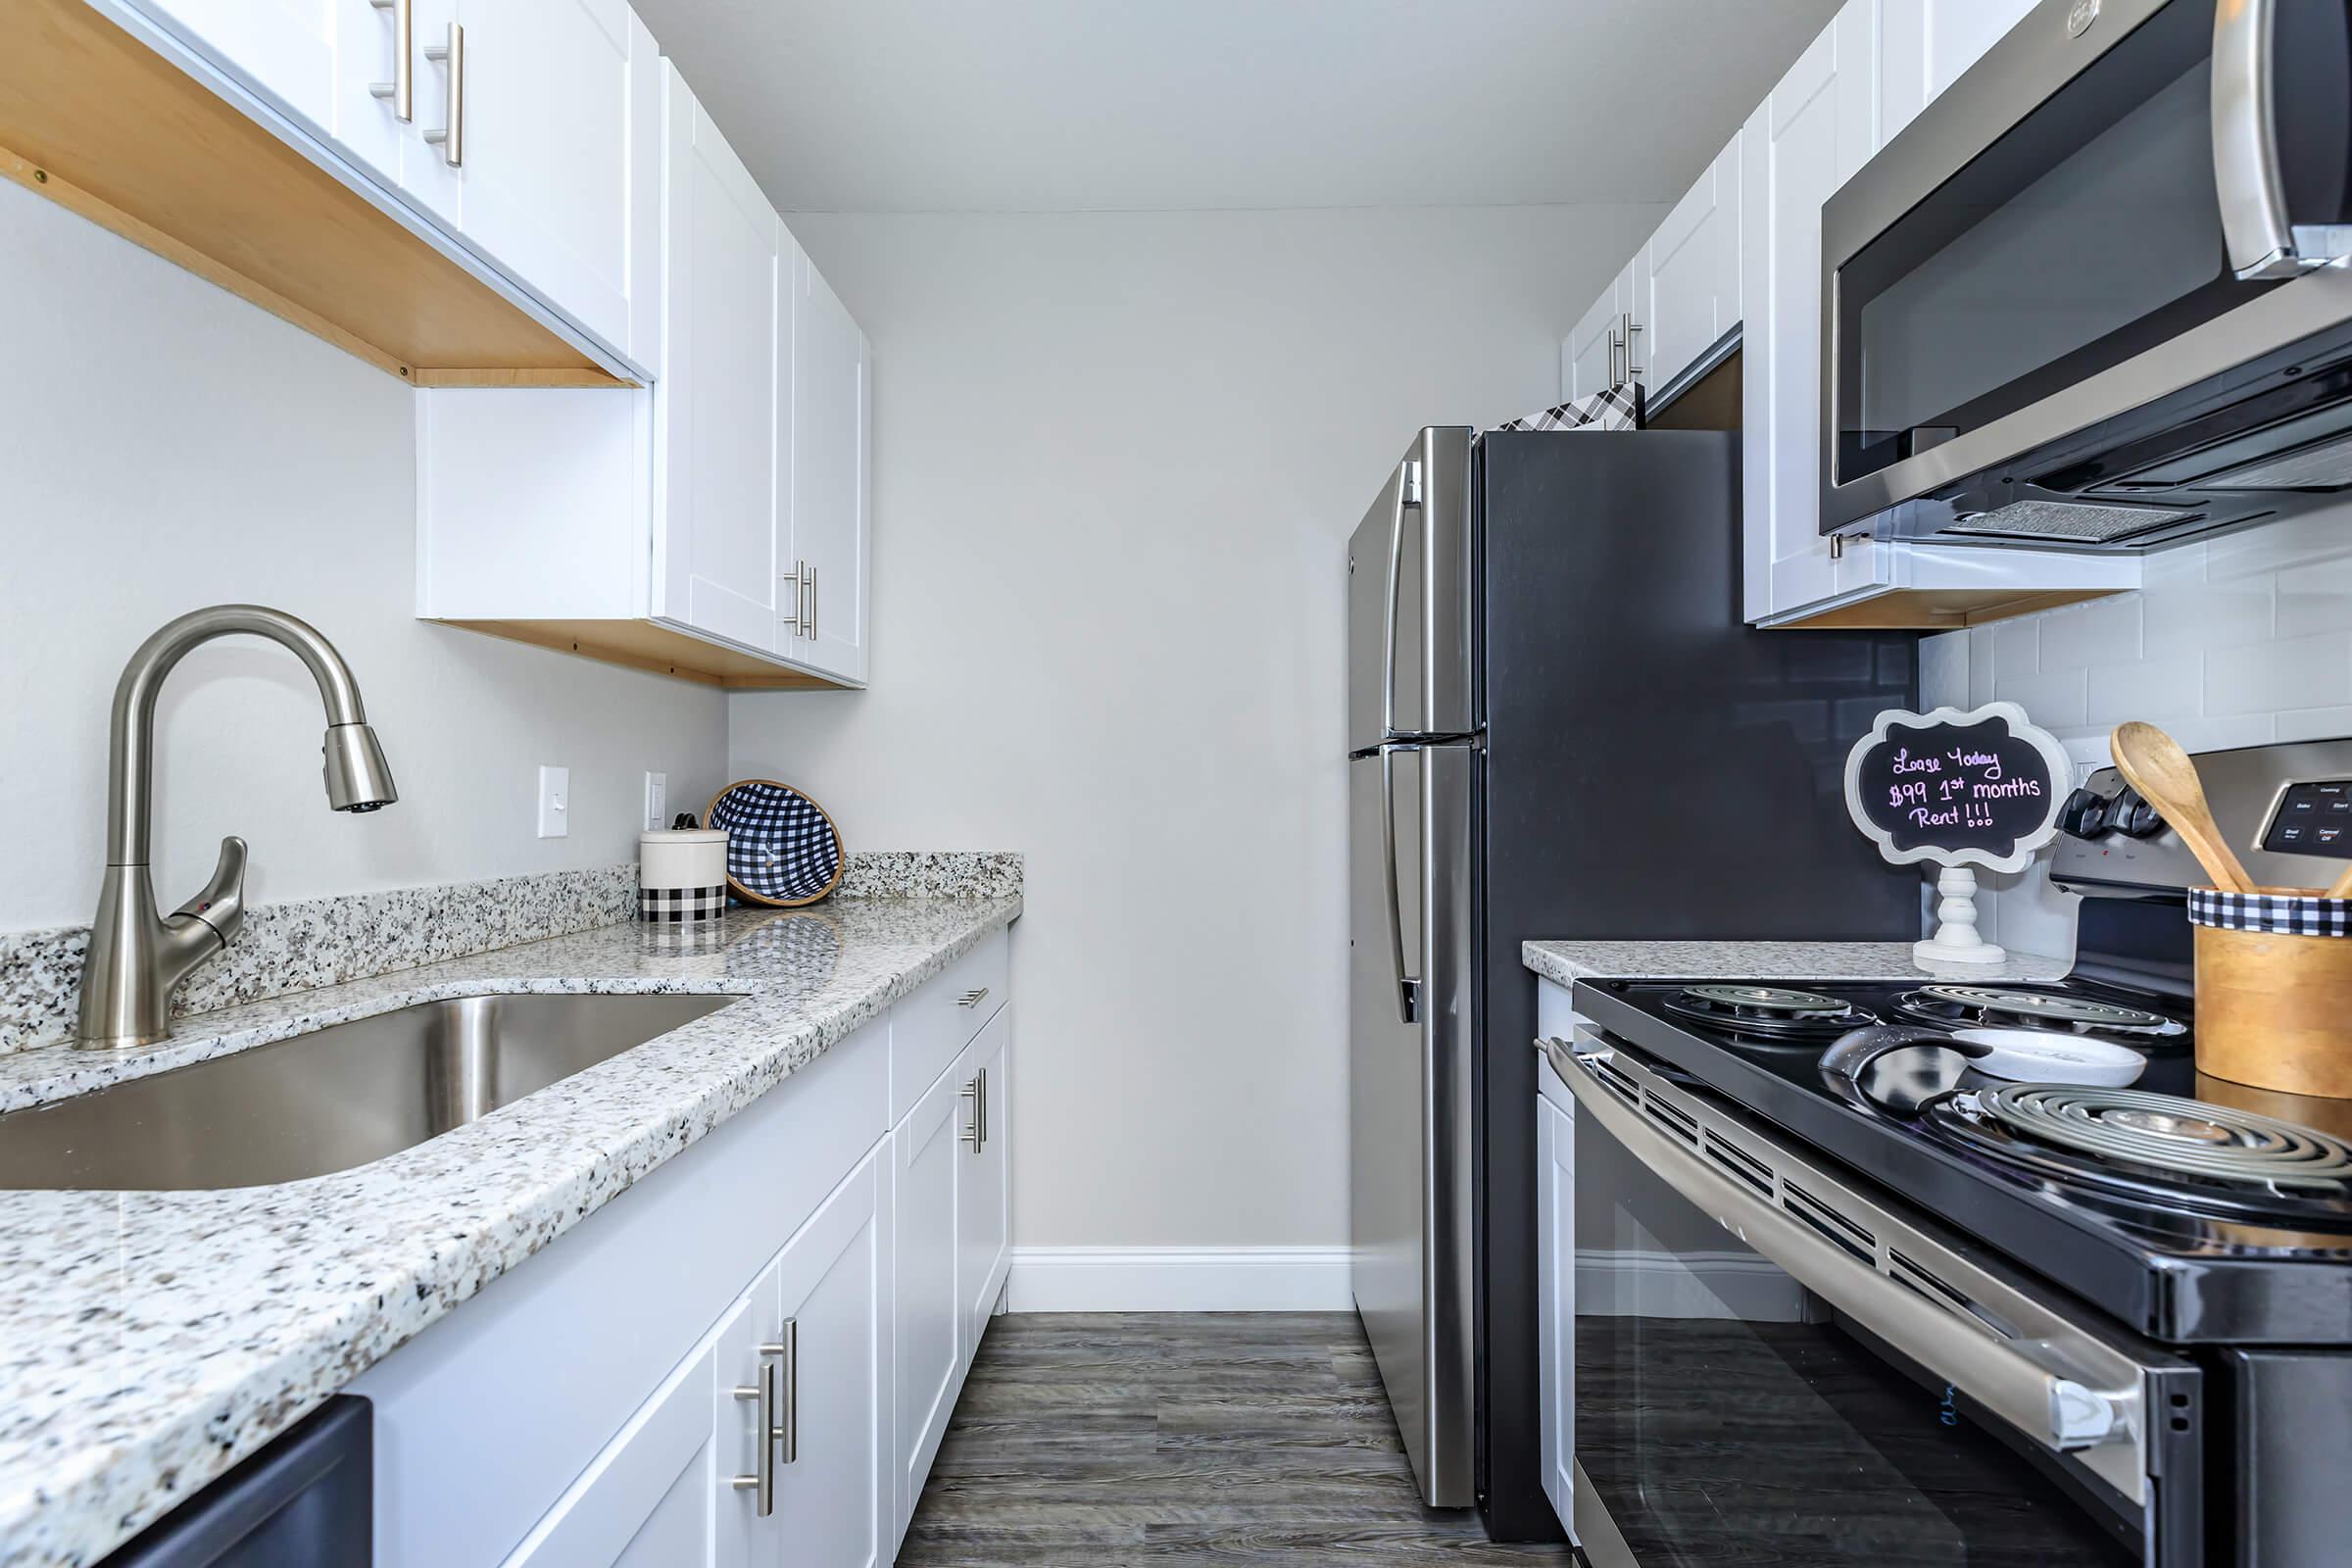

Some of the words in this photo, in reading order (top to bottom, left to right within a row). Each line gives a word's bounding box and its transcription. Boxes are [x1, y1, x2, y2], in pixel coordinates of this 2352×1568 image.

[1892, 747, 1942, 775] Lease
[1946, 747, 2002, 780] Today
[1889, 782, 1928, 808] $99
[1939, 776, 1965, 801] 1st
[1973, 776, 2042, 800] months
